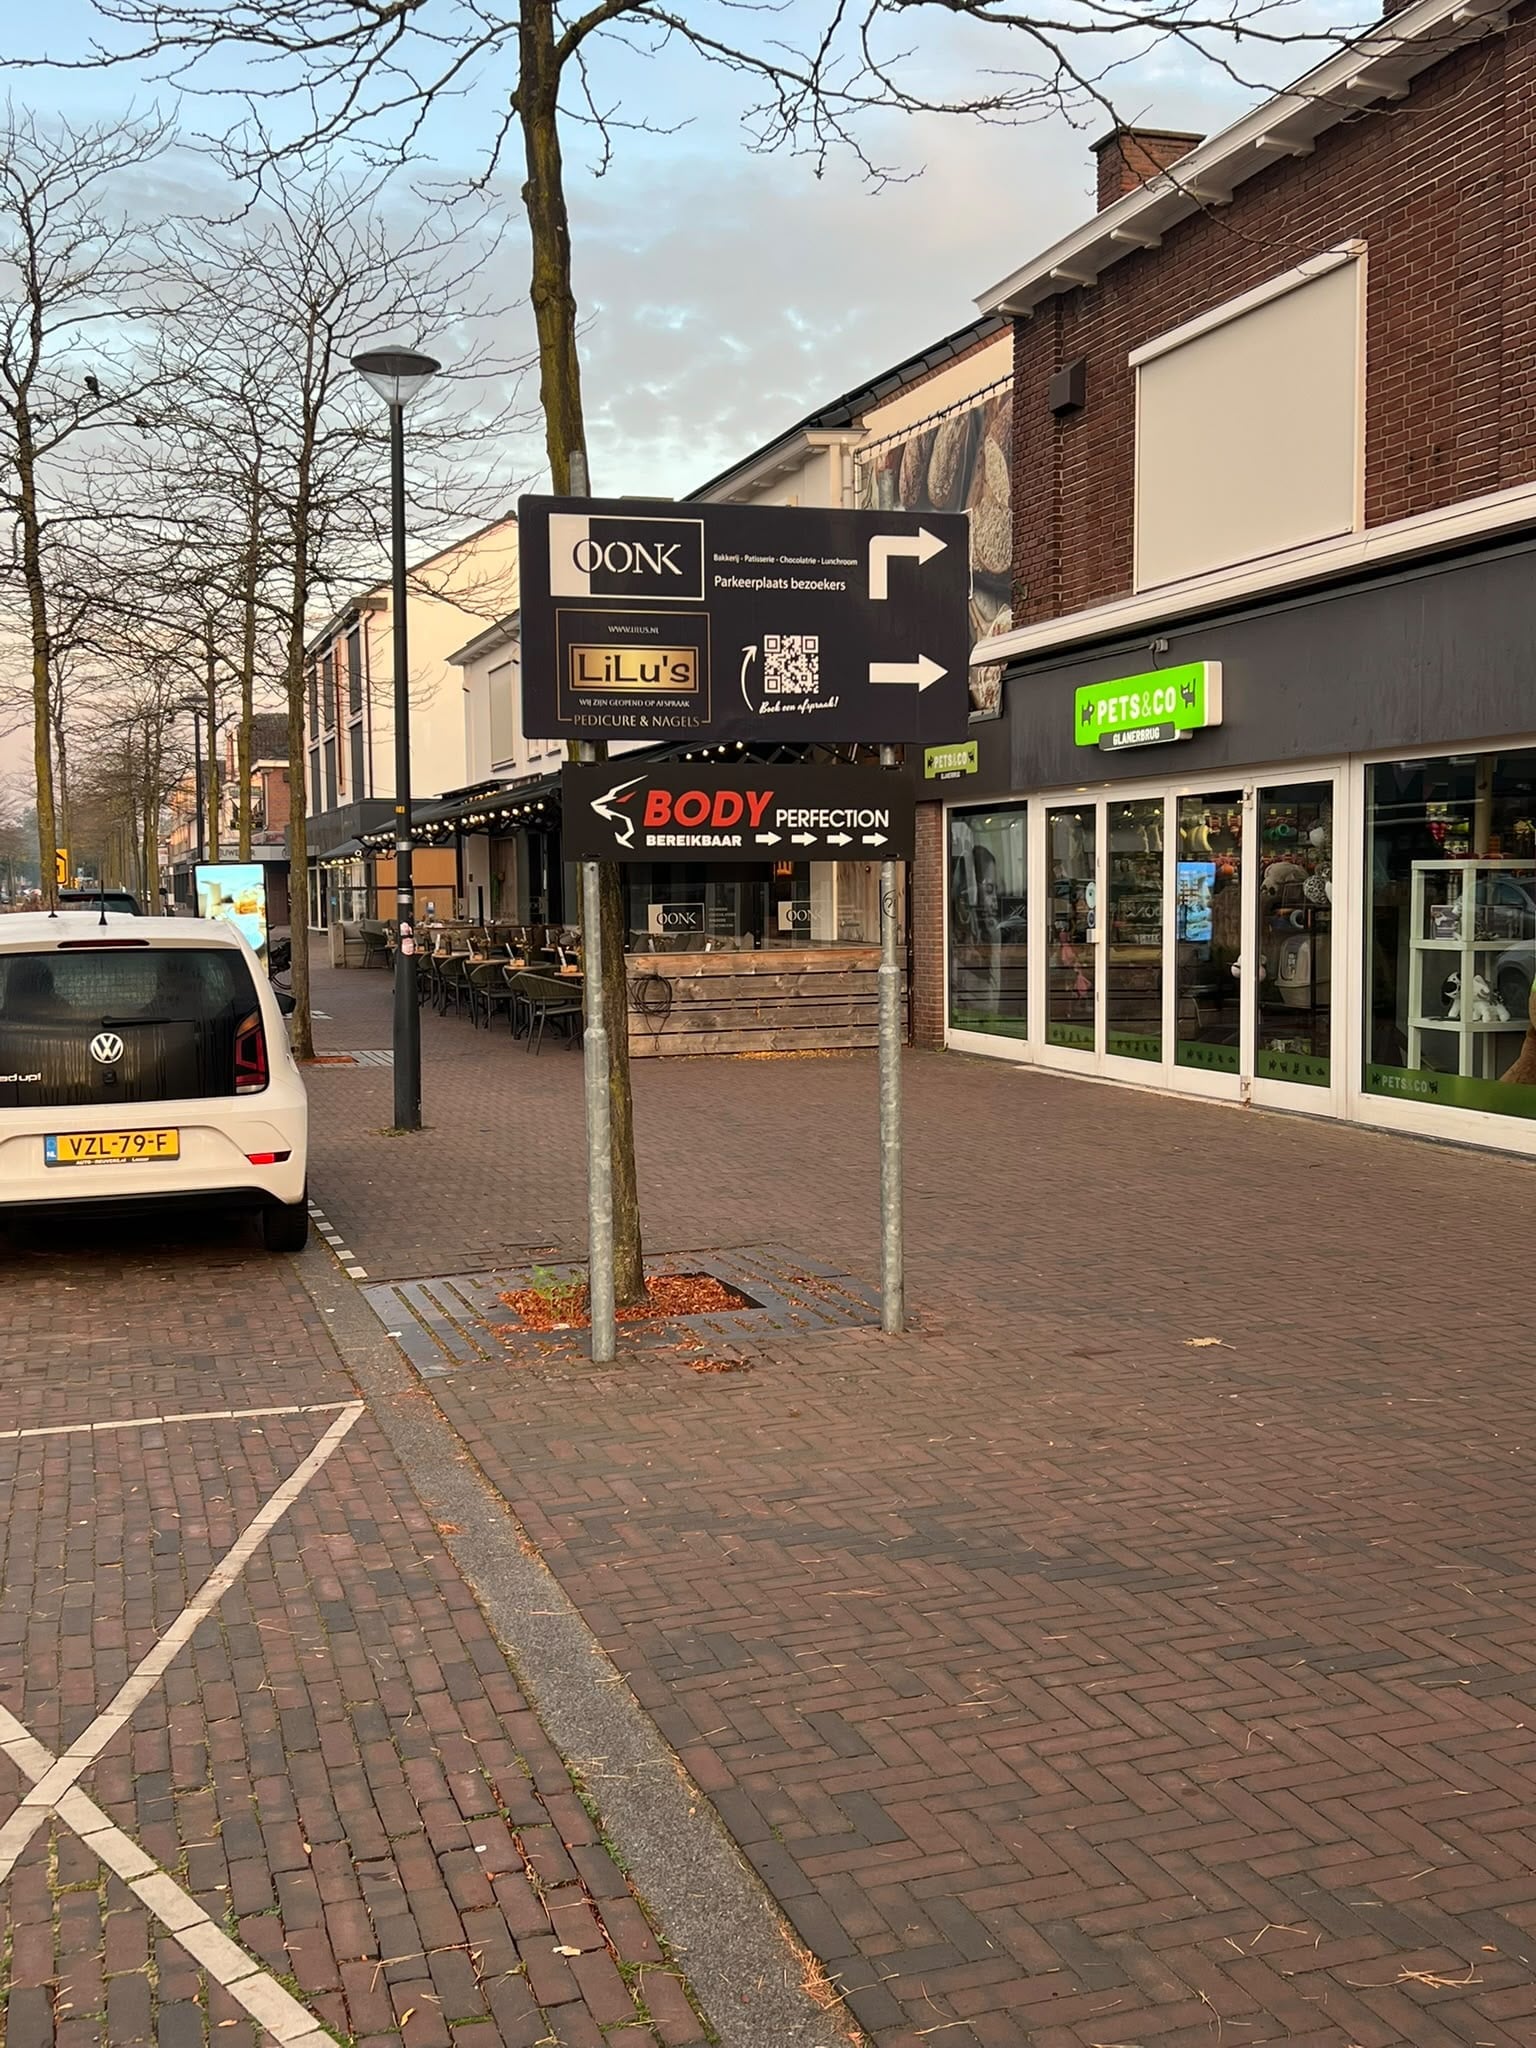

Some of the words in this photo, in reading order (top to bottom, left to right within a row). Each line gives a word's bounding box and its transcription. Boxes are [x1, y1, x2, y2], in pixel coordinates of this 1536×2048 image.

[572, 538, 683, 575] OONK
[713, 553, 740, 563] Bakkerij
[744, 554, 775, 564] Patisserie
[821, 557, 858, 567] Lunchroom
[714, 575, 789, 591] Parkeerplaats
[790, 577, 847, 591] bezoekers
[578, 653, 690, 683] LiLu's
[609, 699, 644, 707] GEOPEND
[782, 704, 796, 712] een
[1097, 686, 1177, 726] PETS&CO
[574, 714, 637, 728] PEDICURE
[639, 715, 649, 727] &
[652, 715, 700, 728] NAGELS
[1113, 727, 1160, 746] GLANERBRUG
[933, 751, 968, 769] PETS&CO
[643, 790, 774, 827] BODY
[776, 808, 889, 828] PERFECTION
[646, 834, 742, 847] BEREIKBAAR
[656, 911, 697, 925] OONK
[18, 1072, 42, 1083] up!
[1382, 1075, 1428, 1093] PETS&CO
[70, 1133, 168, 1156] VZL-79-F
